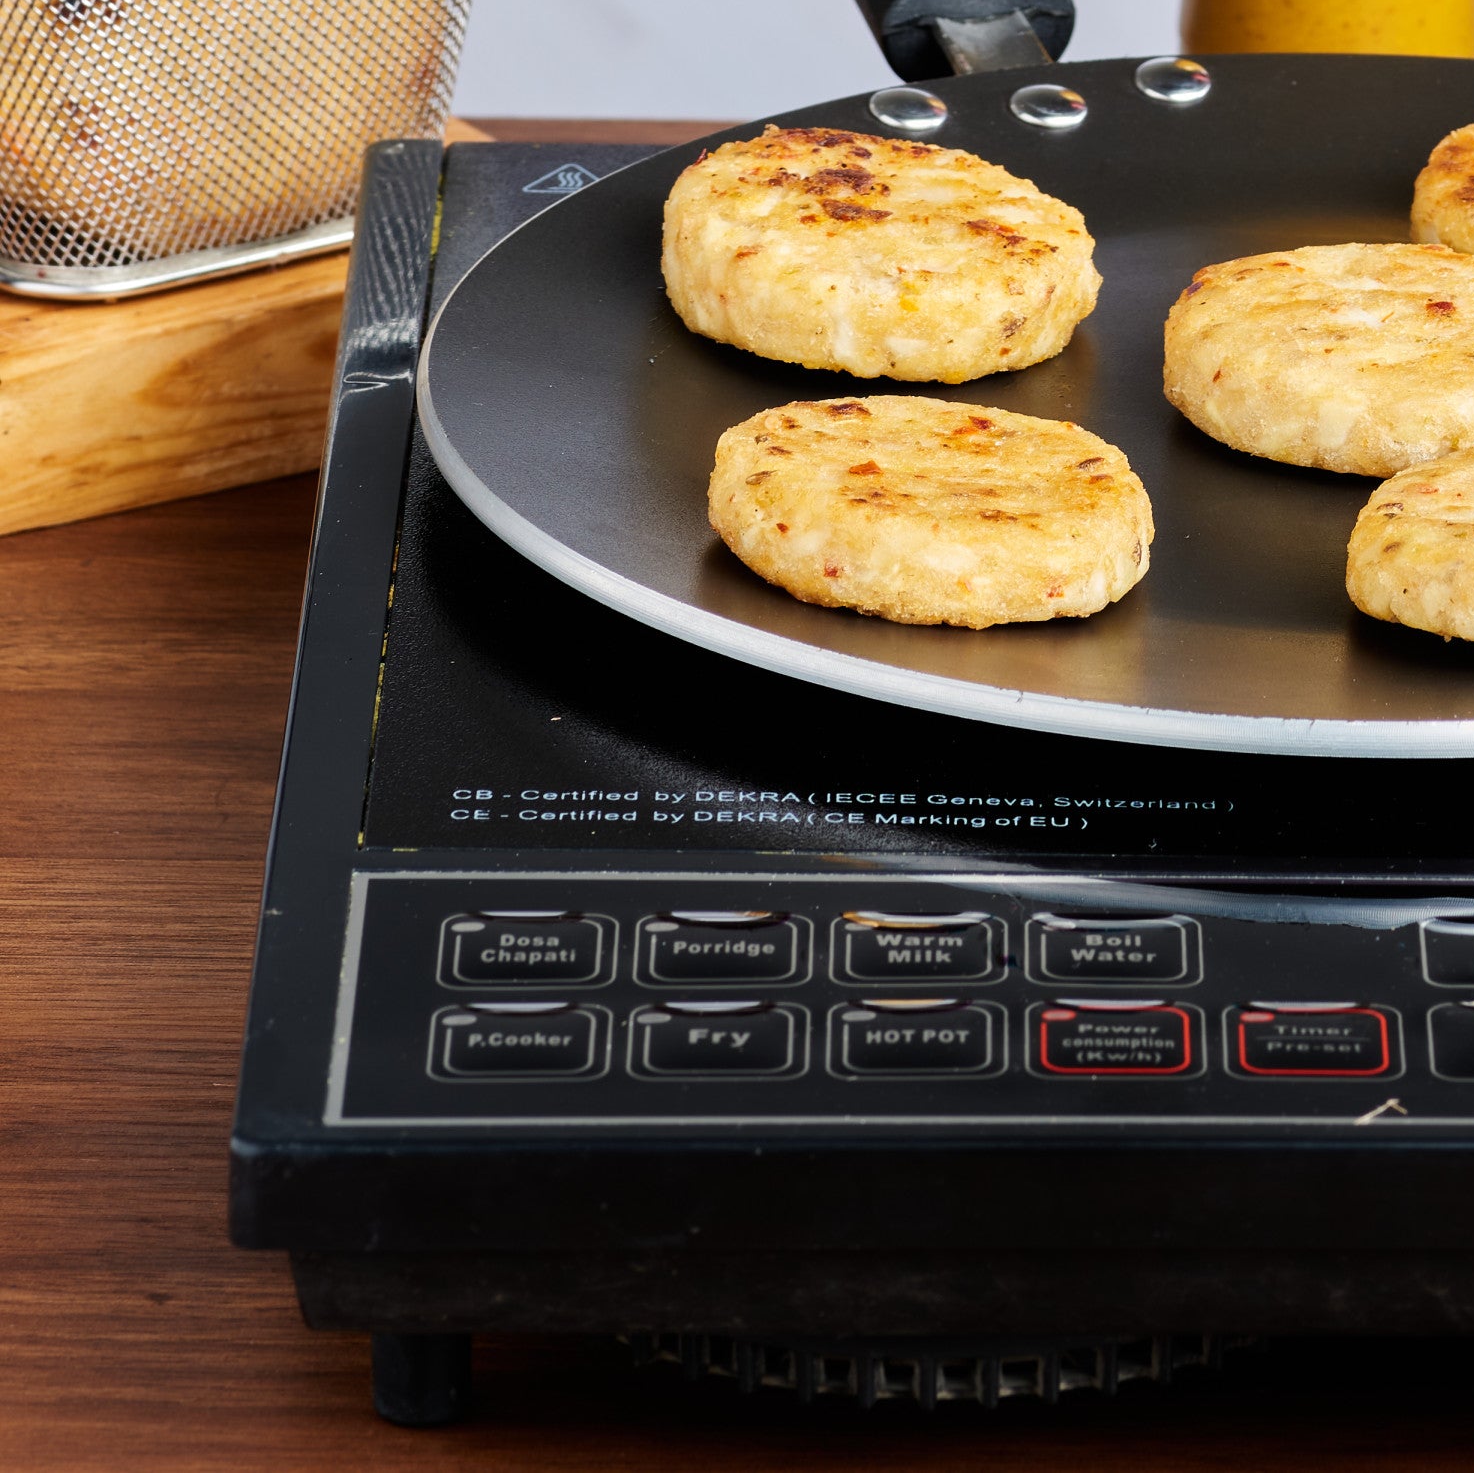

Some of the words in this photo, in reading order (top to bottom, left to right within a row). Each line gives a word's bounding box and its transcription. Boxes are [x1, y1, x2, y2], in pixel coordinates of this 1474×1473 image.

[452, 789, 493, 801] CB
[520, 790, 639, 802] Certified
[655, 791, 685, 803] by
[695, 791, 801, 803] DEKRA
[927, 794, 1043, 807] Geneva,
[1054, 797, 1216, 810] Switzerland
[450, 809, 491, 821] CE
[518, 810, 637, 822] Certified
[653, 811, 684, 824] by
[694, 811, 800, 823] DEKRA
[875, 813, 986, 828] Marking
[995, 815, 1022, 827] of
[1030, 816, 1069, 827] EU
[500, 934, 560, 947] Dosa
[875, 934, 964, 947] Warm
[1085, 934, 1142, 947] Boil
[672, 940, 776, 957] Porridge
[480, 948, 577, 966] Chapati
[887, 949, 952, 963] Milk
[1070, 949, 1157, 963] Water
[1077, 1023, 1160, 1035] Power
[1274, 1024, 1353, 1036] Timer
[468, 1032, 573, 1048] P.Cooker
[688, 1028, 751, 1048] Fry
[865, 1029, 916, 1044] HOT
[922, 1029, 970, 1044] POT
[1061, 1036, 1176, 1050] consumption
